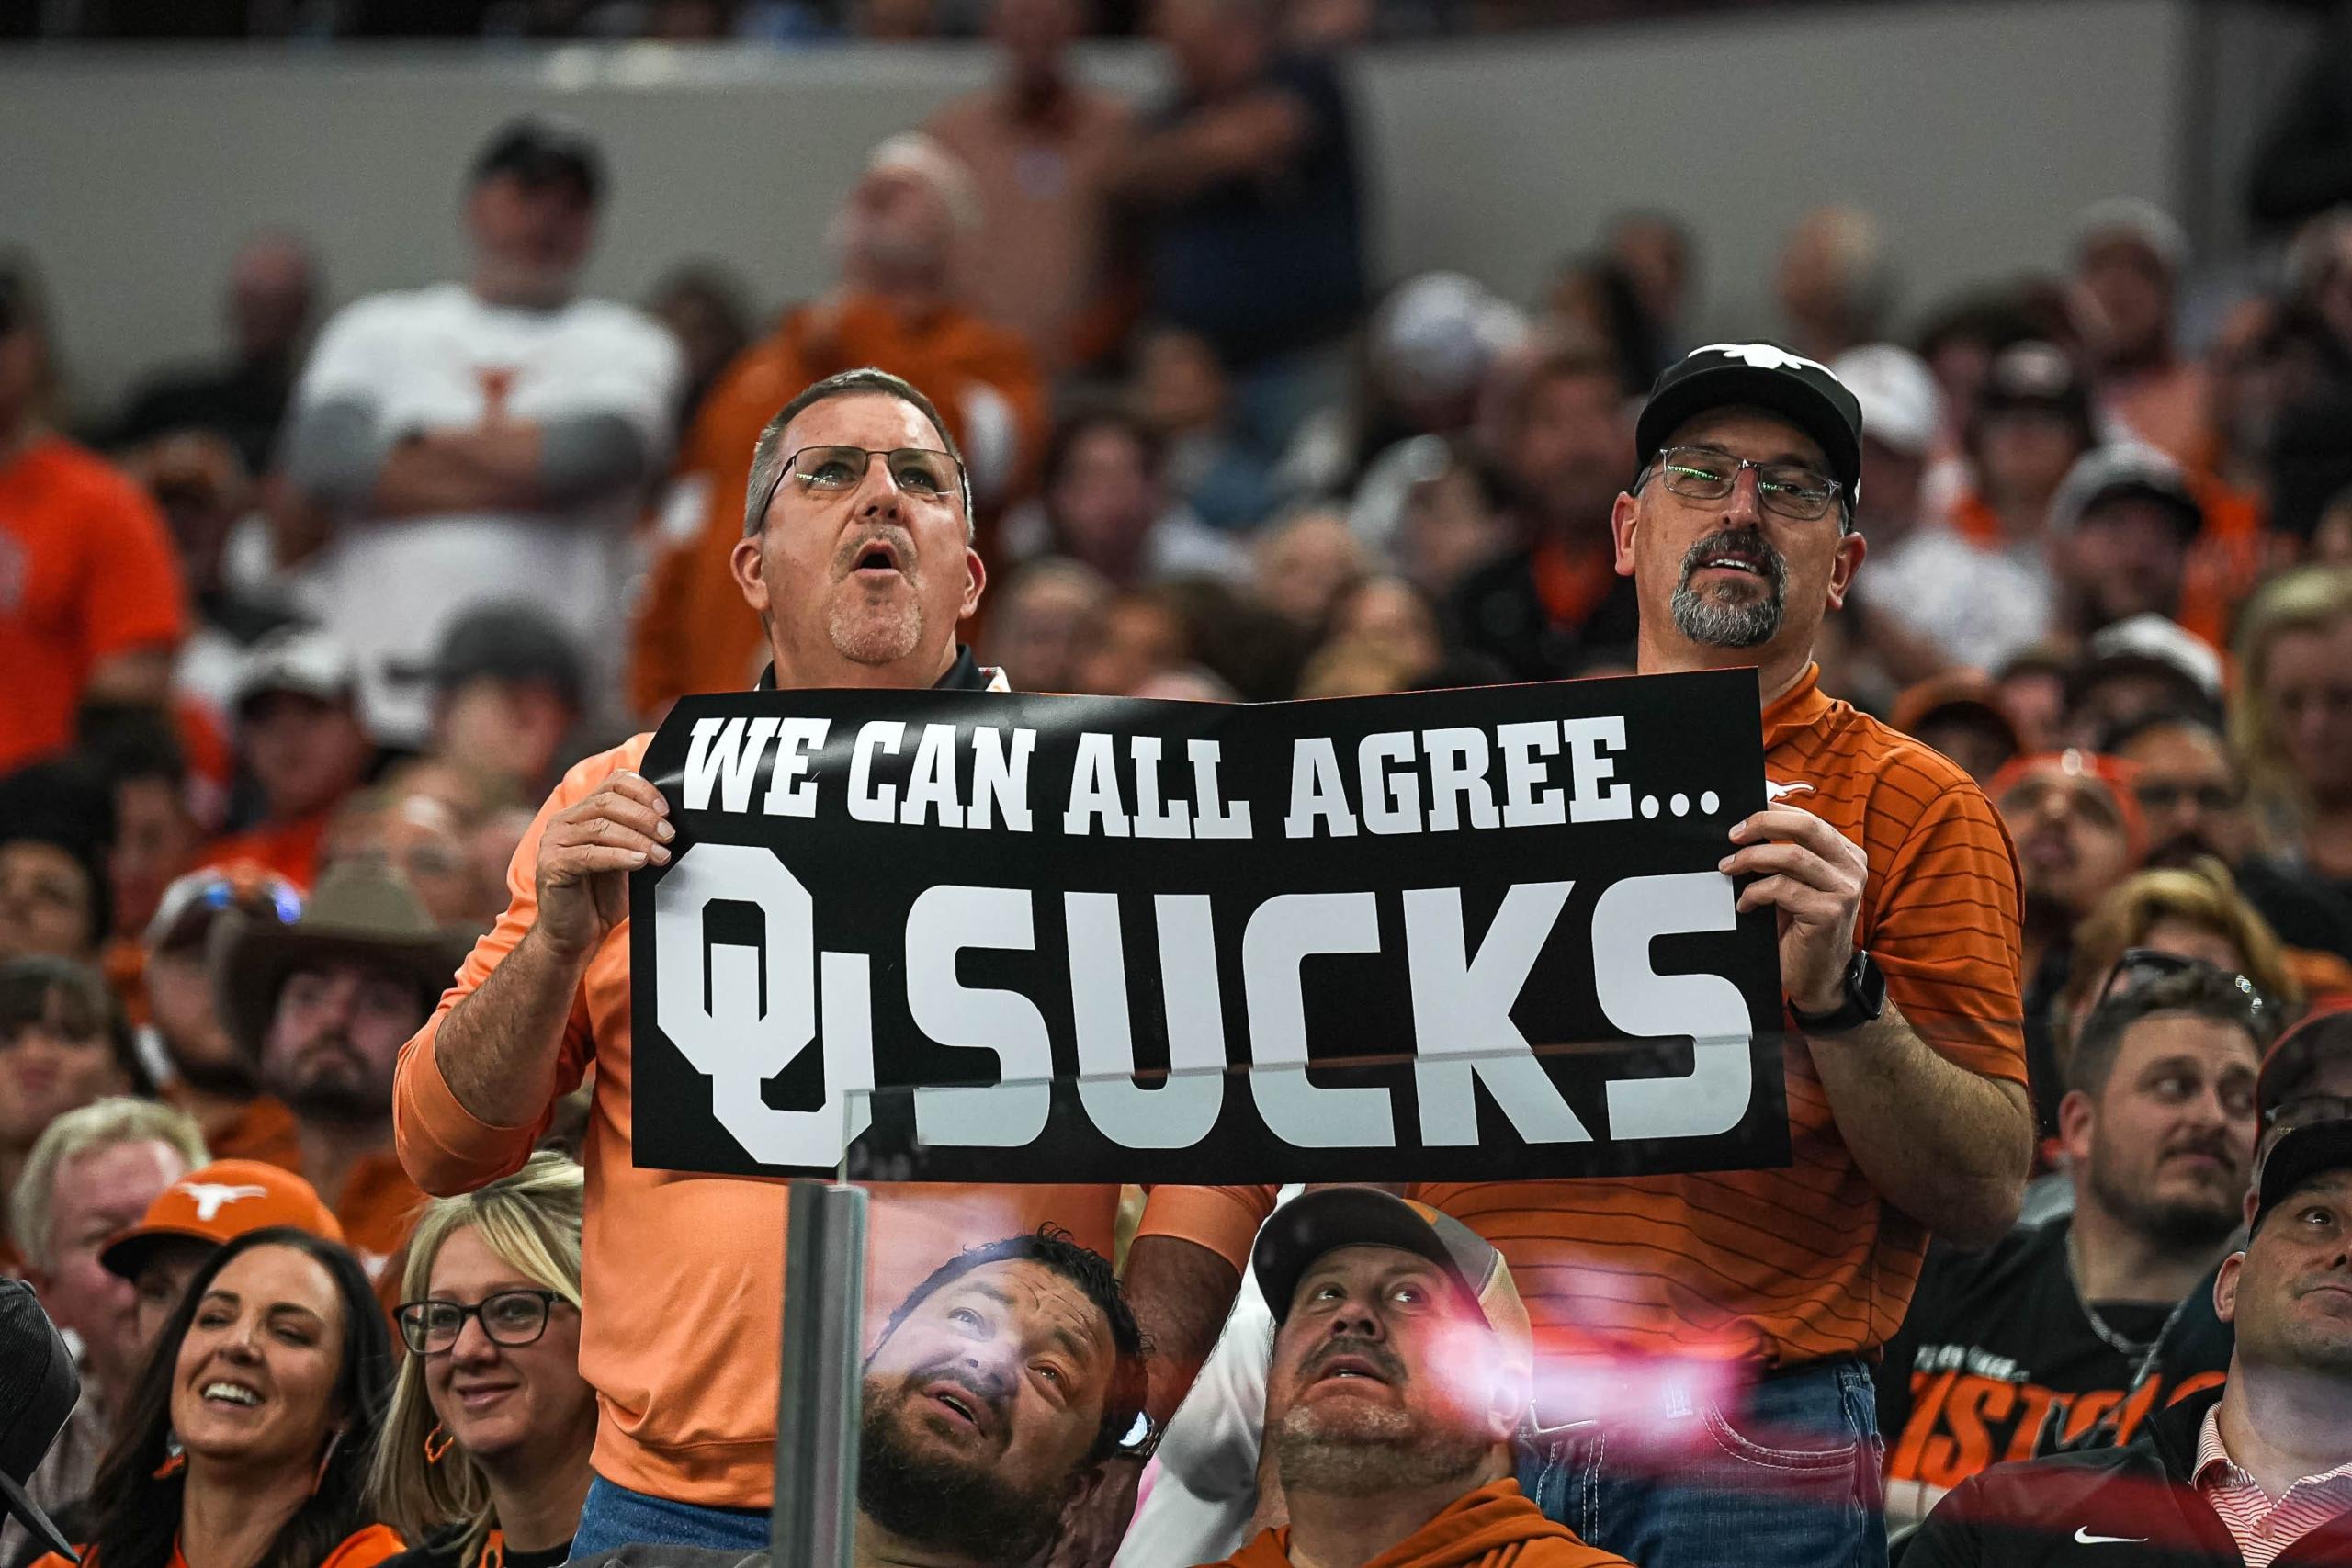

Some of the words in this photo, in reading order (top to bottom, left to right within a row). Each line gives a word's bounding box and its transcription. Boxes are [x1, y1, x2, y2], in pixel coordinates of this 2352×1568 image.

[683, 716, 832, 818] WE
[847, 720, 1034, 832] CAN
[1063, 731, 1253, 840] ALL
[1283, 715, 1721, 839] AGREE...
[655, 842, 876, 1168] OU
[905, 871, 1753, 1148] SUCKS
